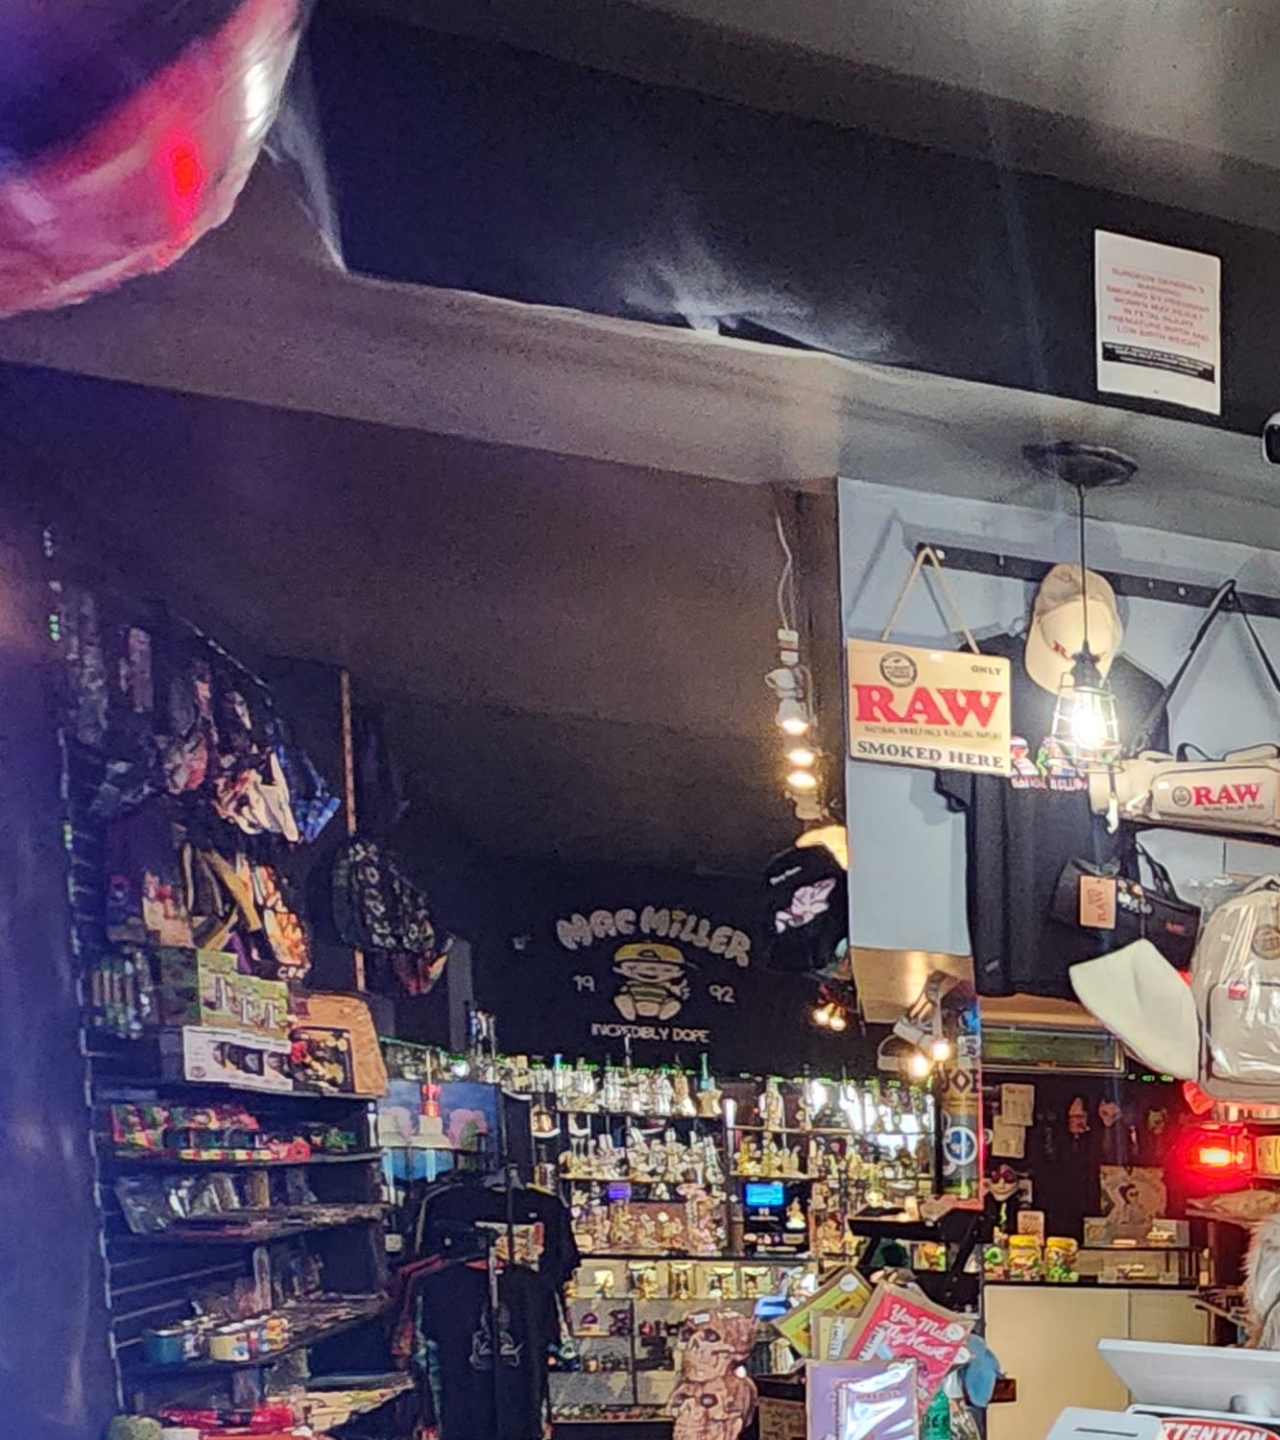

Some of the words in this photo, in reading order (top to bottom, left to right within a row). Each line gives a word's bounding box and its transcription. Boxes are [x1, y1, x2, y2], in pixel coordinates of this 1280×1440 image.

[970, 664, 1003, 677] ONLY
[852, 683, 1004, 729] RAW
[857, 739, 943, 764] SMOKED
[948, 750, 1004, 770] HERE
[1192, 783, 1264, 806] RAW
[556, 908, 638, 950] MAC
[572, 975, 596, 993] 19
[708, 984, 736, 1004] 92
[671, 1029, 712, 1044] DOPE
